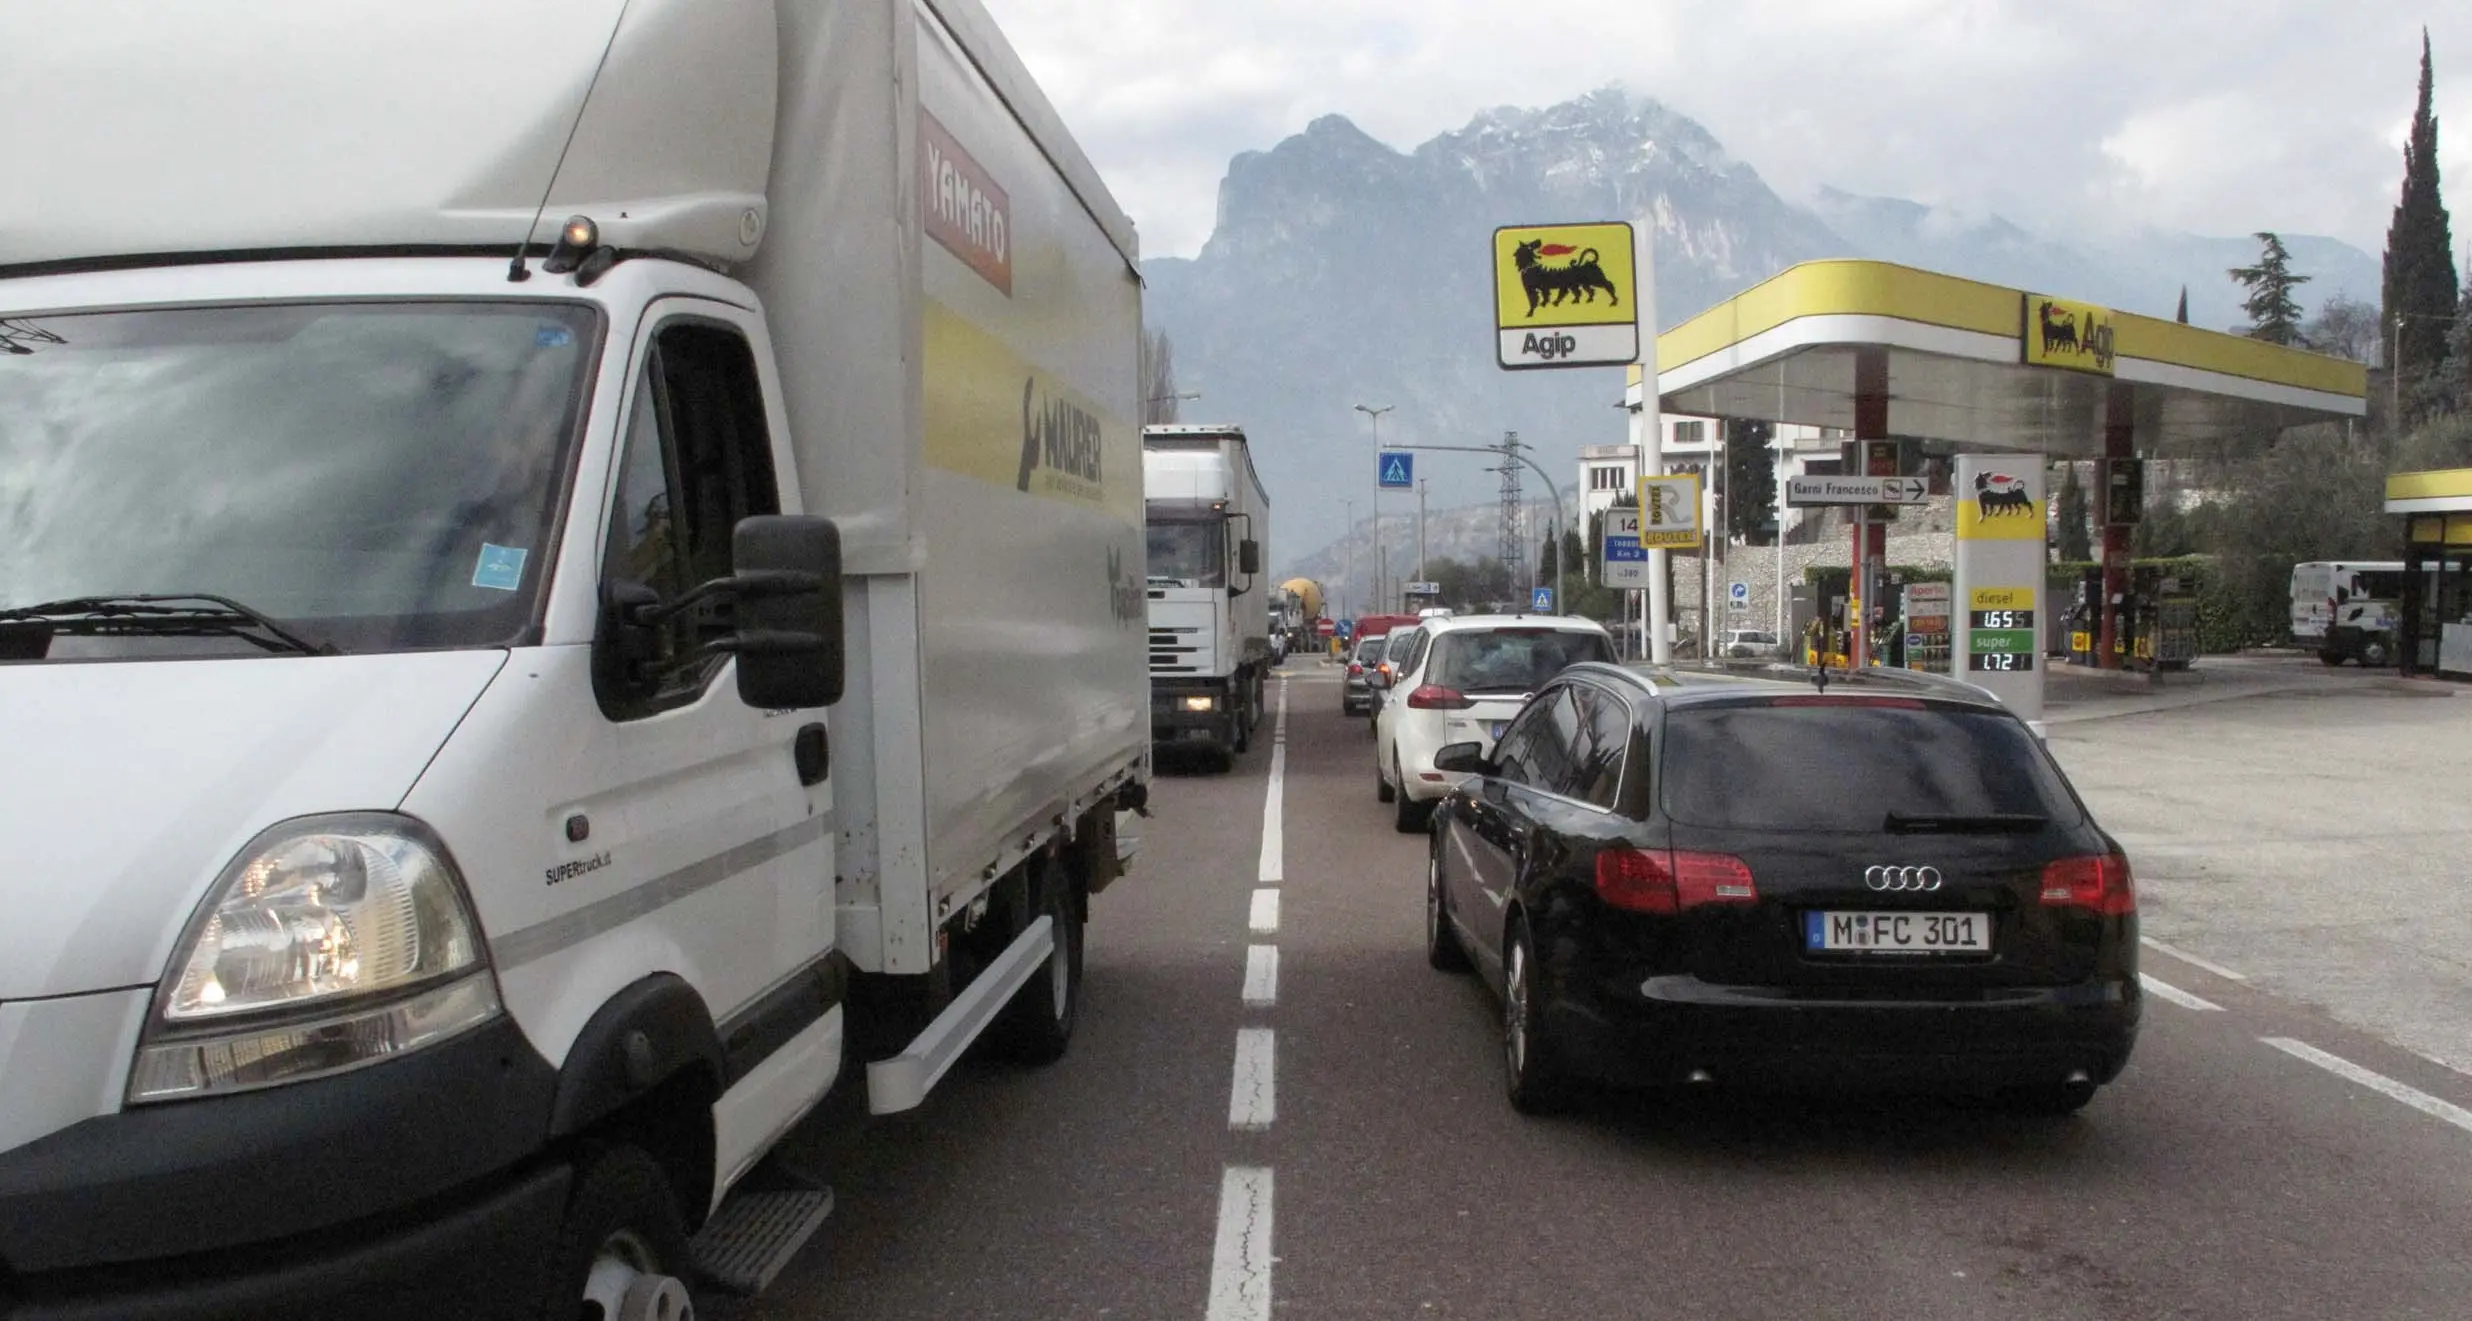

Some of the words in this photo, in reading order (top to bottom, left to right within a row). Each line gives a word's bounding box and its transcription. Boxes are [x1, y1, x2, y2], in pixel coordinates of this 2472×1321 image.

[928, 140, 1004, 264] YAMATO
[1522, 332, 1577, 360] Agip
[1794, 482, 1822, 494] Garni
[1826, 482, 1878, 495] Francesco
[1620, 518, 1639, 532] 14
[1976, 591, 2014, 604] diesel
[1976, 637, 2012, 650] super
[1873, 916, 1911, 945] FC
[1923, 916, 1978, 946] 301
